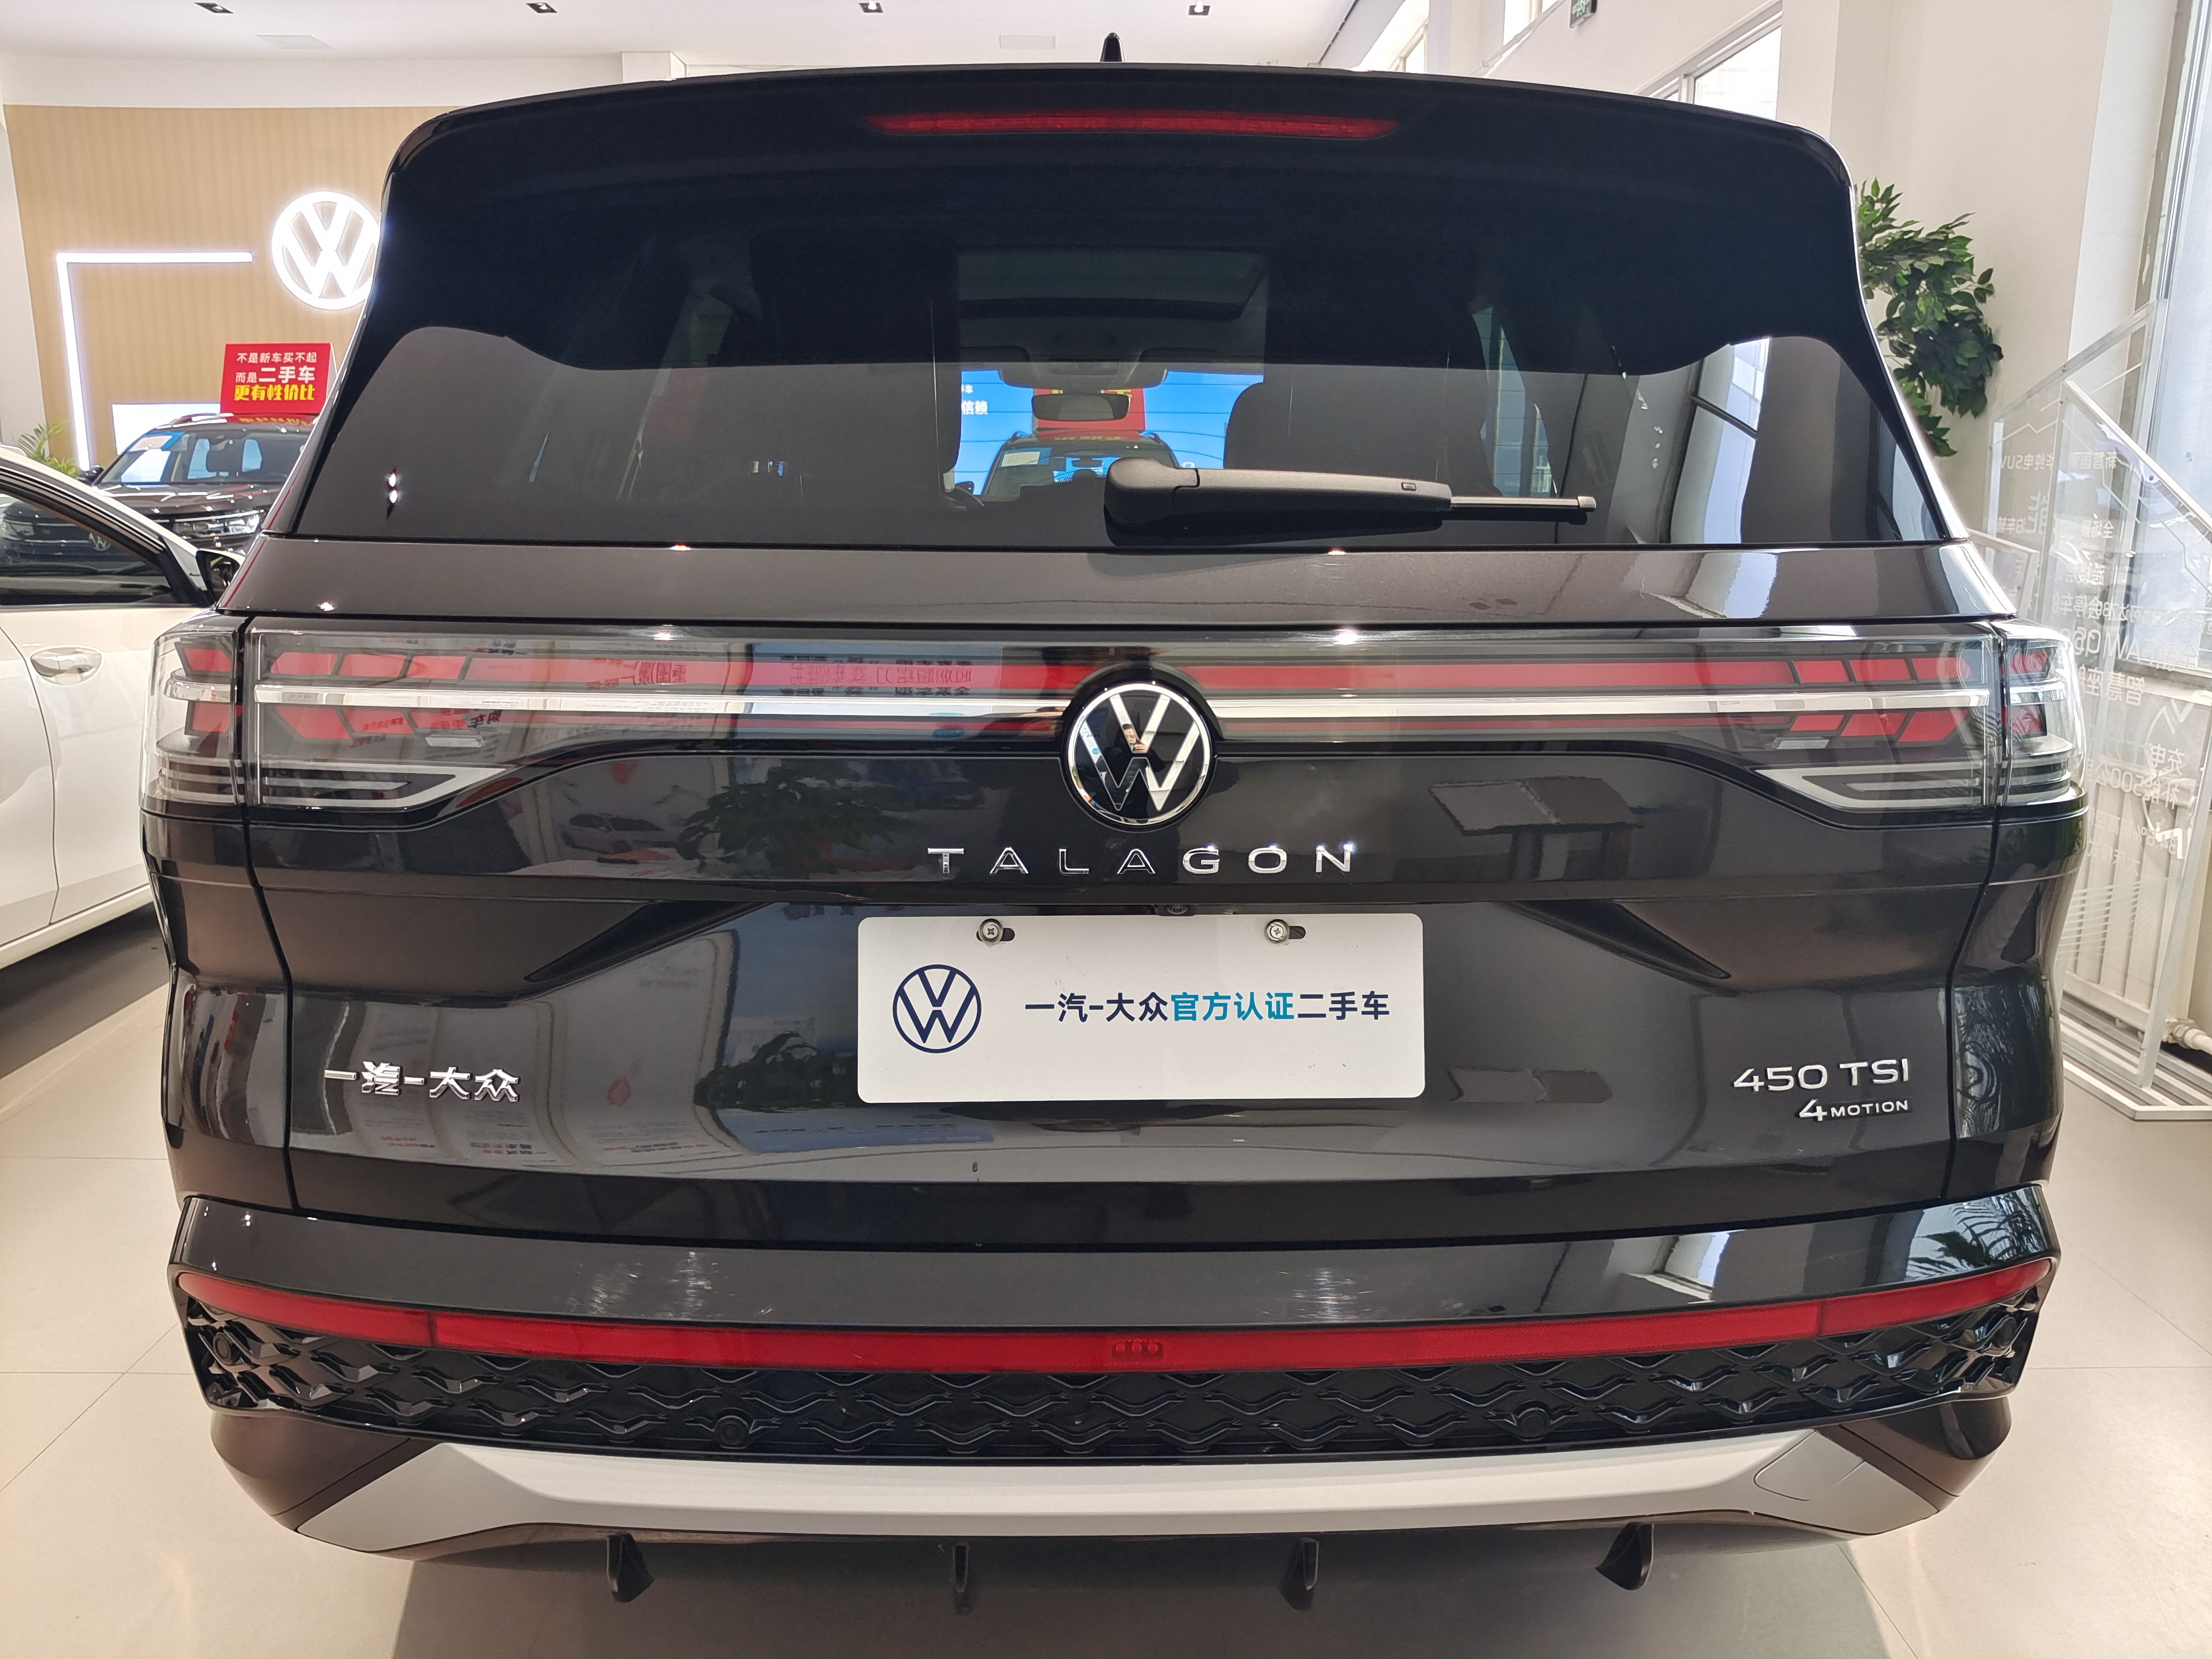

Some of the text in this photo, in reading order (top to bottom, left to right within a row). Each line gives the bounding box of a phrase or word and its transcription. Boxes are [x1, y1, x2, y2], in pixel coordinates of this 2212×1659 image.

[237, 352, 317, 363] 不是新车买不起
[233, 384, 316, 401] 更有性价比
[927, 843, 1353, 875] TALAGON
[1025, 990, 1390, 1022] 一汽-大众官方认证二手车
[324, 1061, 519, 1102] 一汽-大众
[1733, 1058, 1909, 1092] 450 TSI
[1798, 1098, 1908, 1121] 4MOTION
